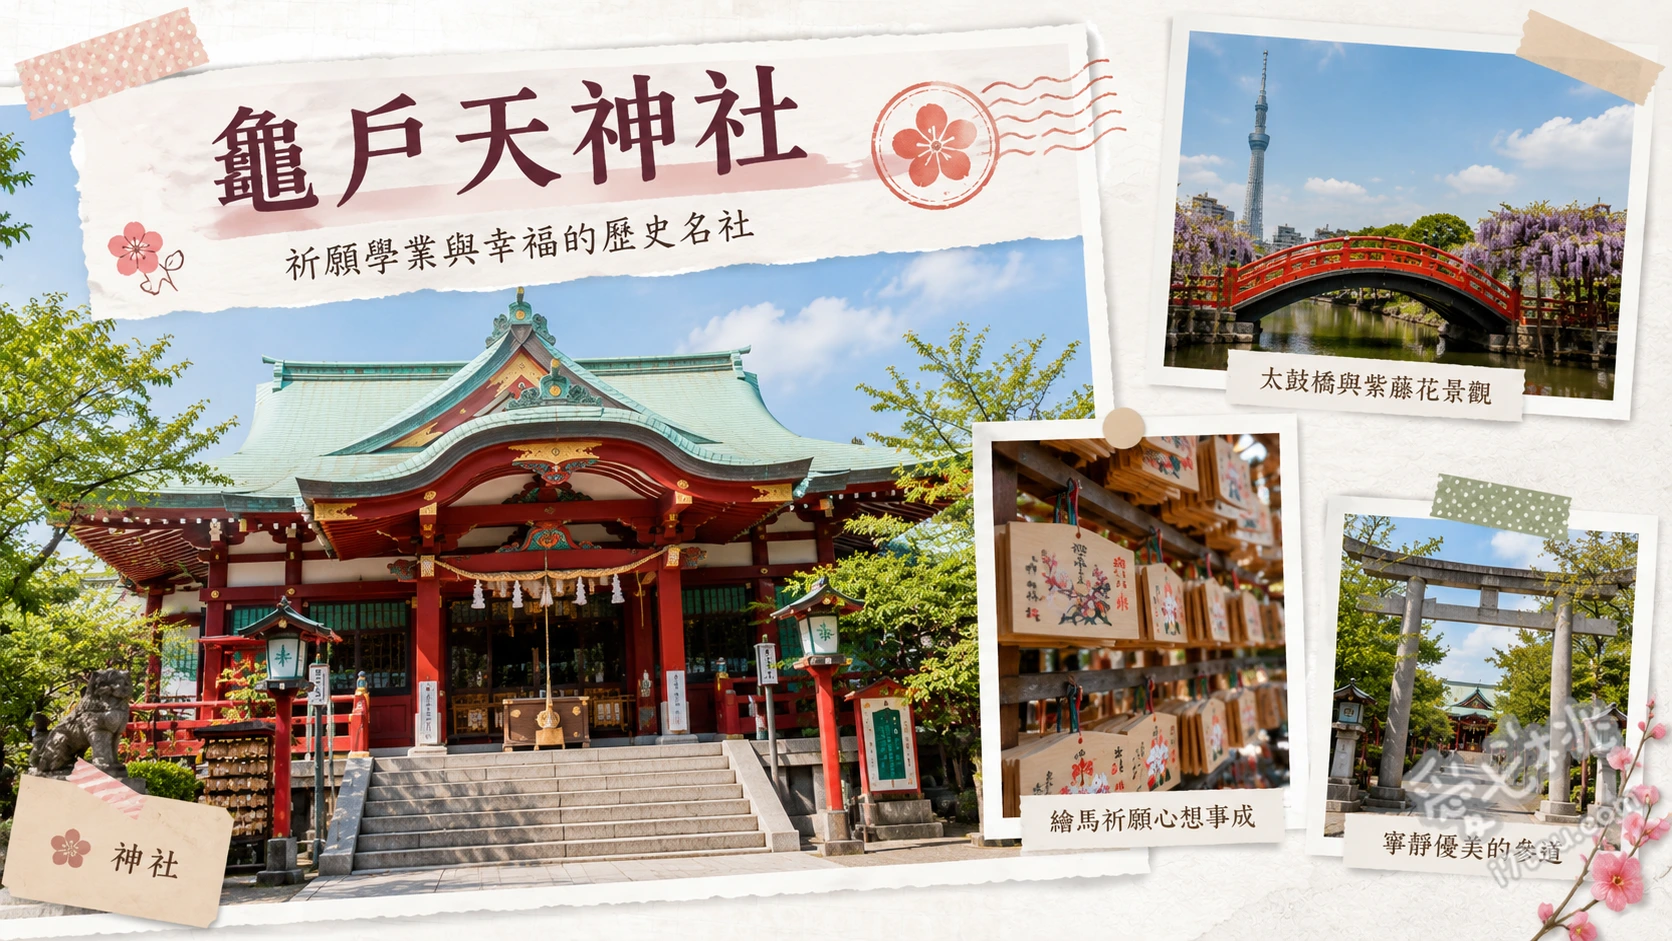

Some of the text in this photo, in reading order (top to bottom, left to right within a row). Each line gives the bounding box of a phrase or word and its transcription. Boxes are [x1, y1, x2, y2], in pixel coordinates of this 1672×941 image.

[212, 65, 807, 212] 龜戶天神社
[284, 208, 756, 281] 祈願學業與幸福的歷史名社
[1260, 366, 1492, 406] 太鼓橋與紫藤花景觀
[1050, 803, 1256, 834] 繪馬祈願心想事成
[110, 841, 180, 880] 神社
[1382, 830, 1563, 866] 寧靜優美的參道
